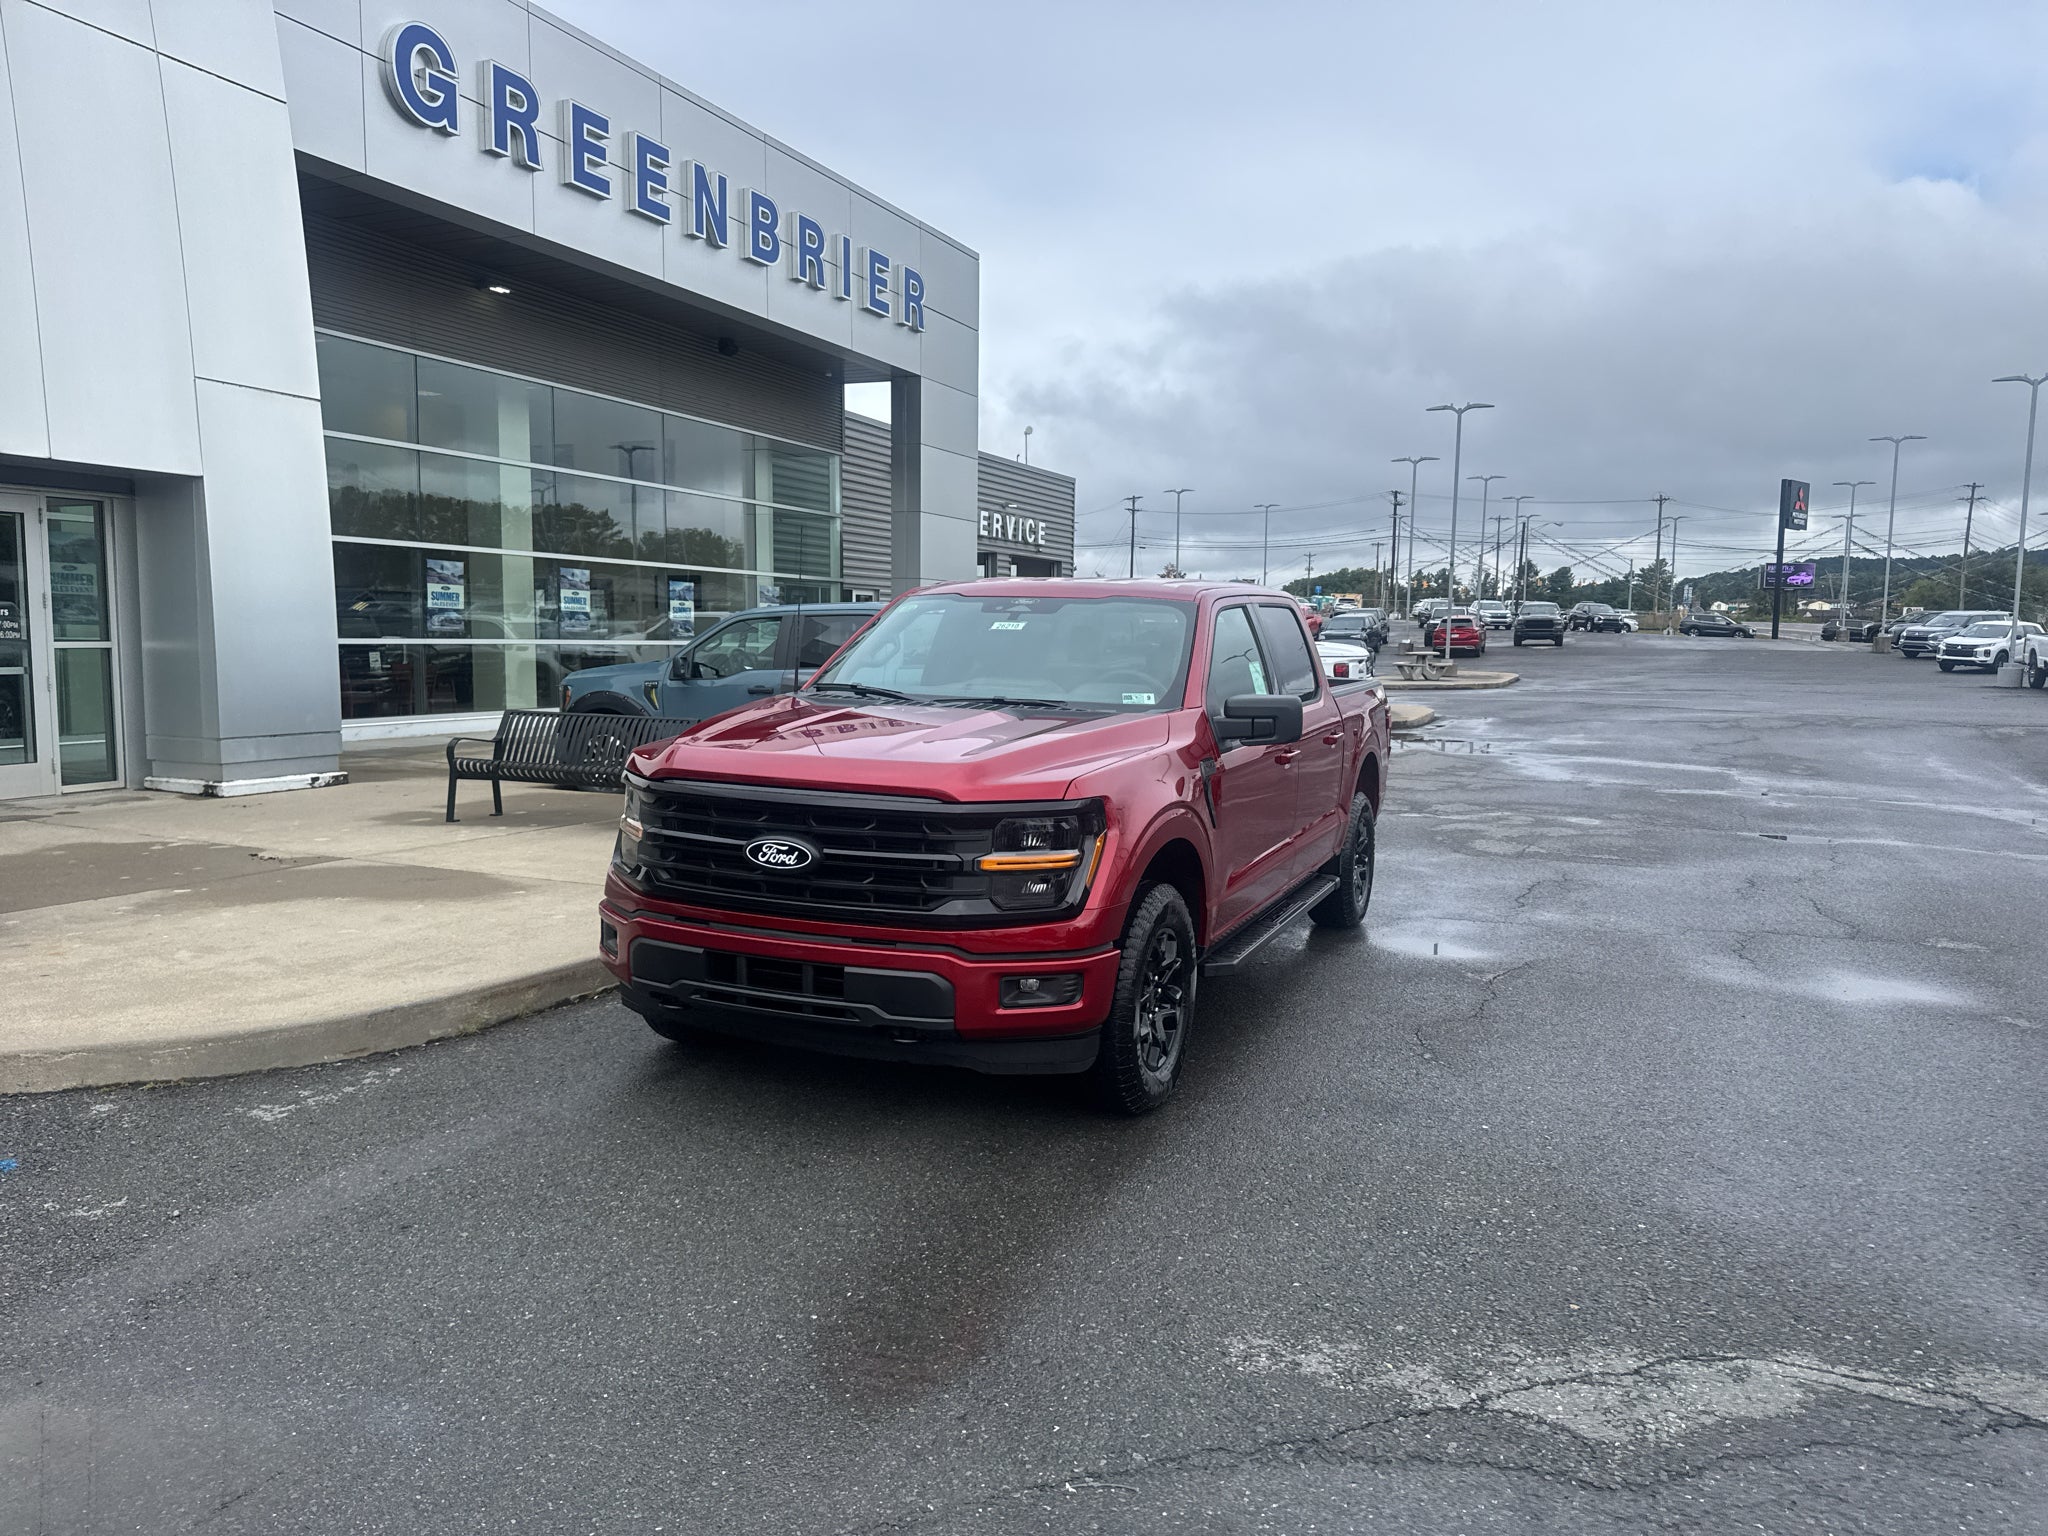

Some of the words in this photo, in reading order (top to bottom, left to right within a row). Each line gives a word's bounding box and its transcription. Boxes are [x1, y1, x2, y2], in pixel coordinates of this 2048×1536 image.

[386, 20, 926, 333] GREENBRIER
[980, 511, 1046, 545] ERVICE
[431, 591, 460, 602] SUMMER
[563, 596, 587, 606] SUMMER
[757, 843, 799, 865] Ford
